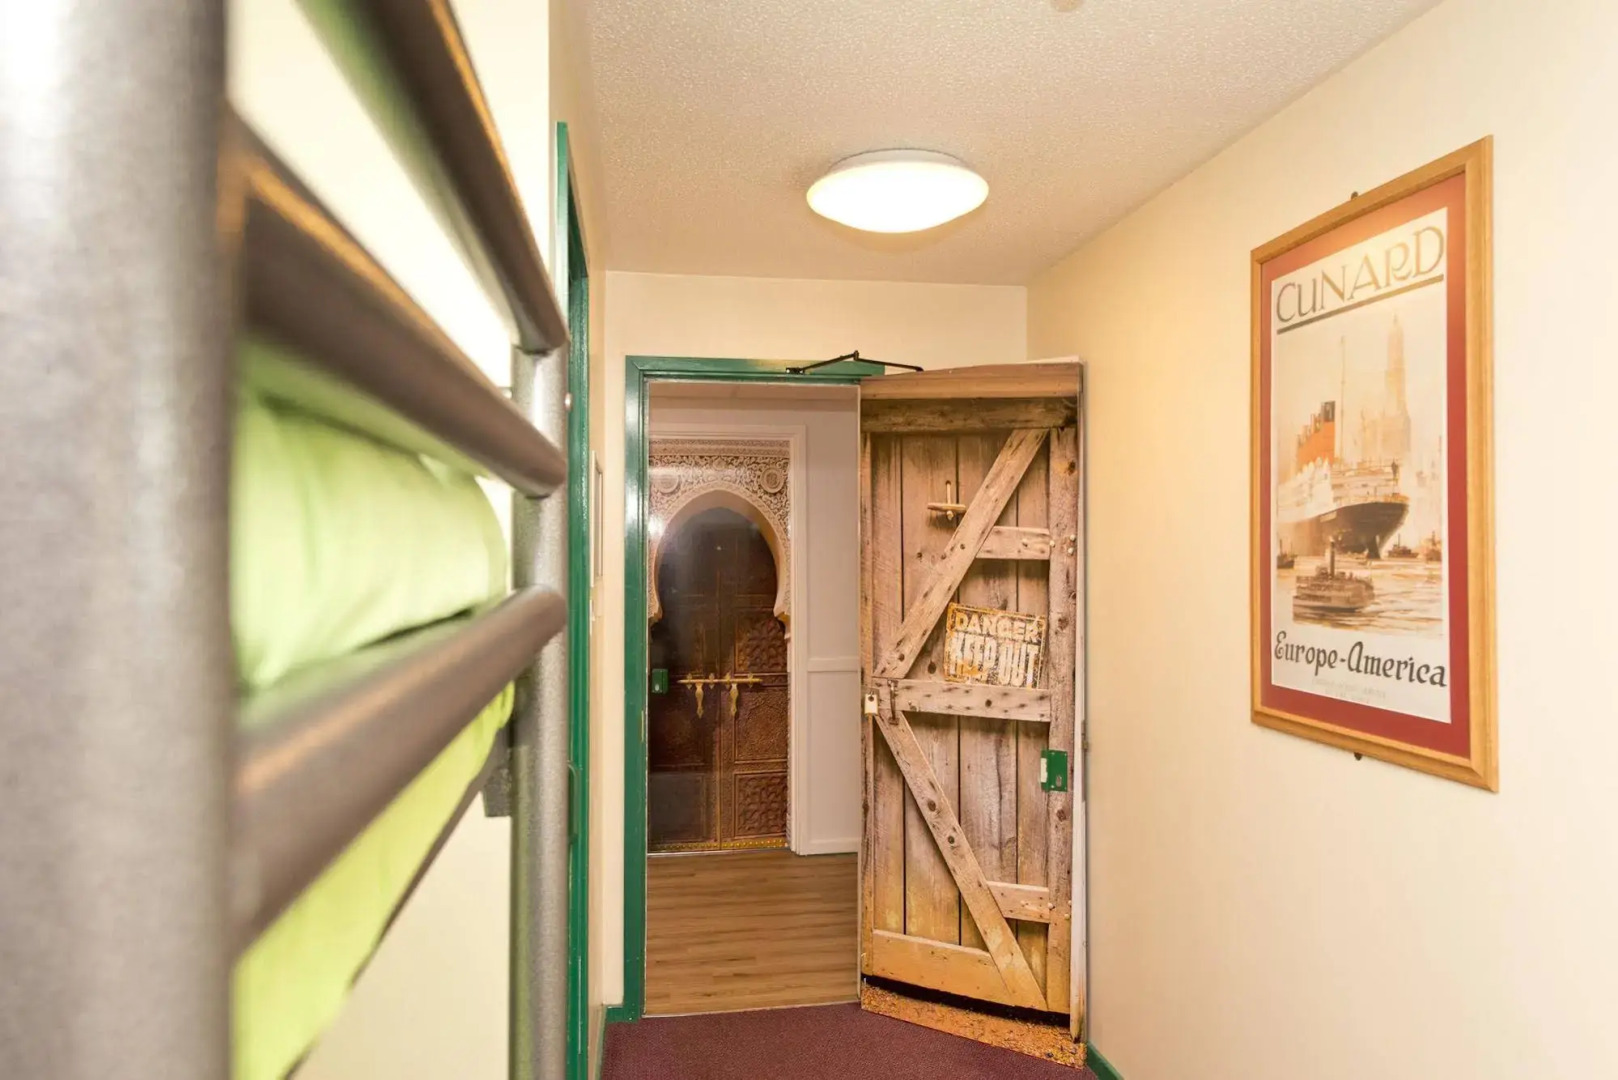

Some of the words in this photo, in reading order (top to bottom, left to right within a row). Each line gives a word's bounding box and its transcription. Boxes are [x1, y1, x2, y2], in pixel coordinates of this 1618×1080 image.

[1276, 226, 1445, 323] CUNARD
[954, 612, 1041, 643] DANGER
[998, 641, 1039, 690] OUT
[1274, 630, 1447, 687] Europe-America
